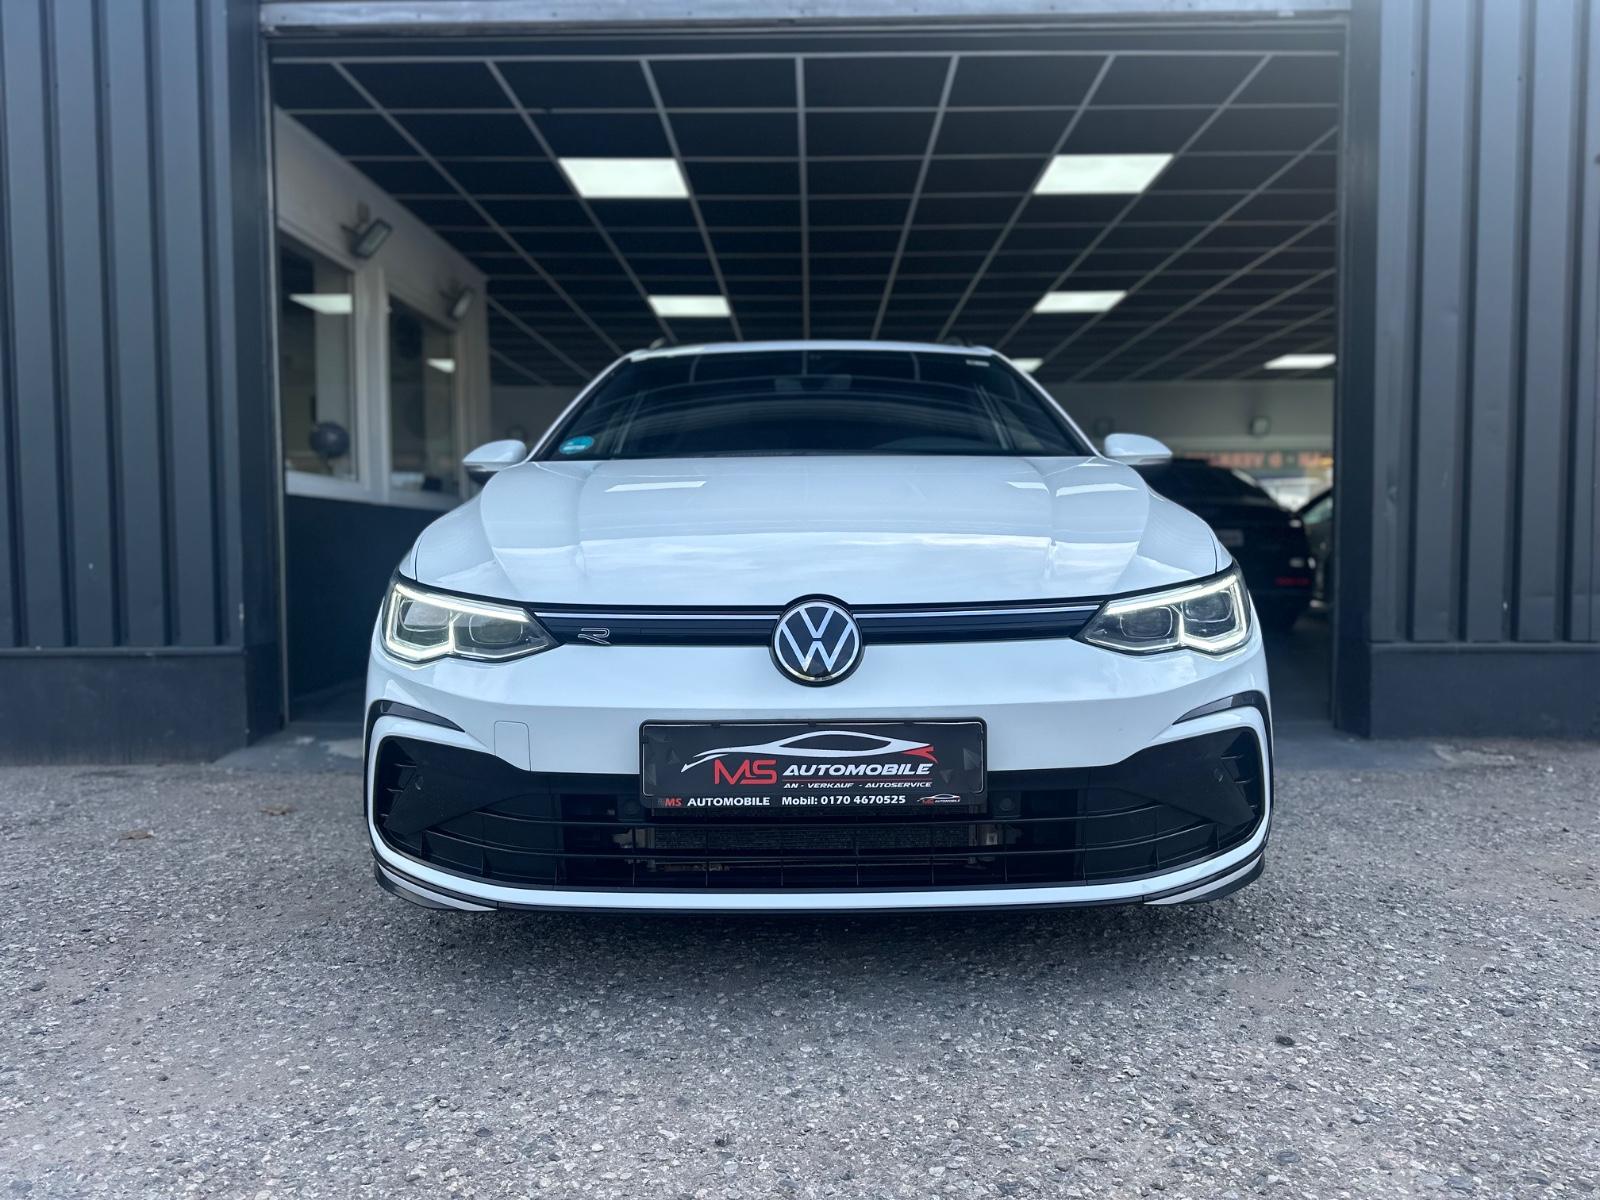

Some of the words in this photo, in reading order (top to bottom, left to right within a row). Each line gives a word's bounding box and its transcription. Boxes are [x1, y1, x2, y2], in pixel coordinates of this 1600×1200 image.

[714, 759, 777, 785] MS
[782, 763, 933, 776] AUTOMOBILE
[664, 798, 682, 807] MS
[687, 797, 771, 807] AUTOMOBILE
[781, 796, 818, 806] Mobil:
[820, 796, 850, 805] 0170
[853, 795, 906, 805] 4670525
